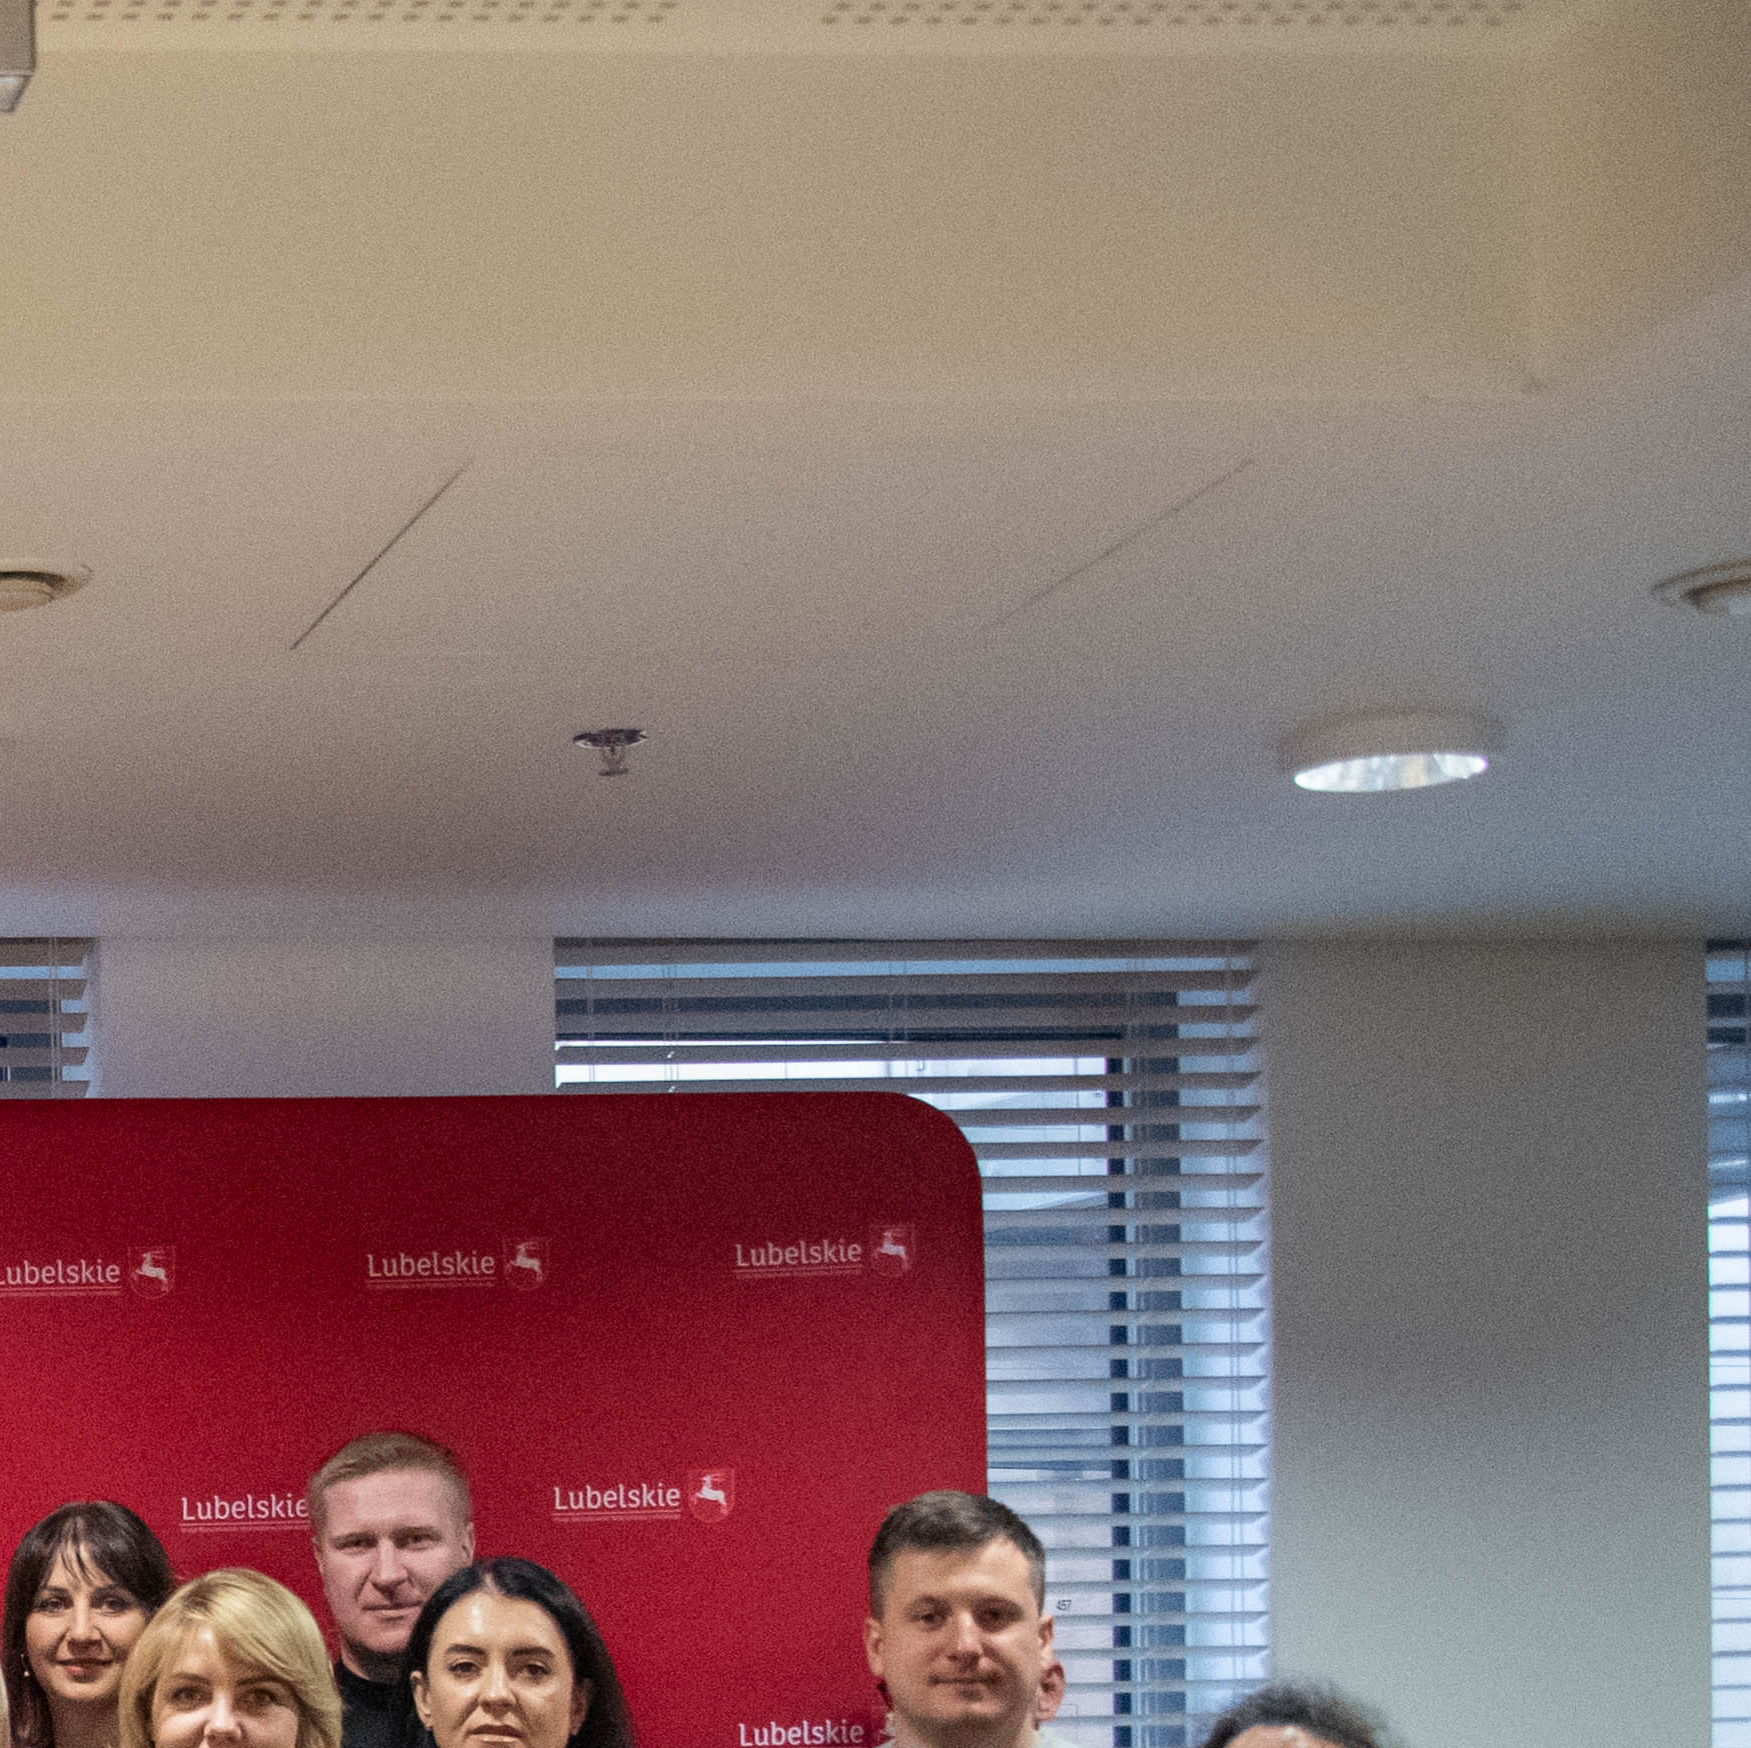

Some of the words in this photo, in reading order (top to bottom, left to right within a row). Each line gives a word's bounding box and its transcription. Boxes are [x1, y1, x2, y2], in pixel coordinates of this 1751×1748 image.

[366, 1250, 495, 1279] Lubelskie
[735, 1239, 862, 1267] Lubelskie
[553, 1483, 681, 1510] Lubelskie
[738, 1719, 865, 1747] Lubelskie
